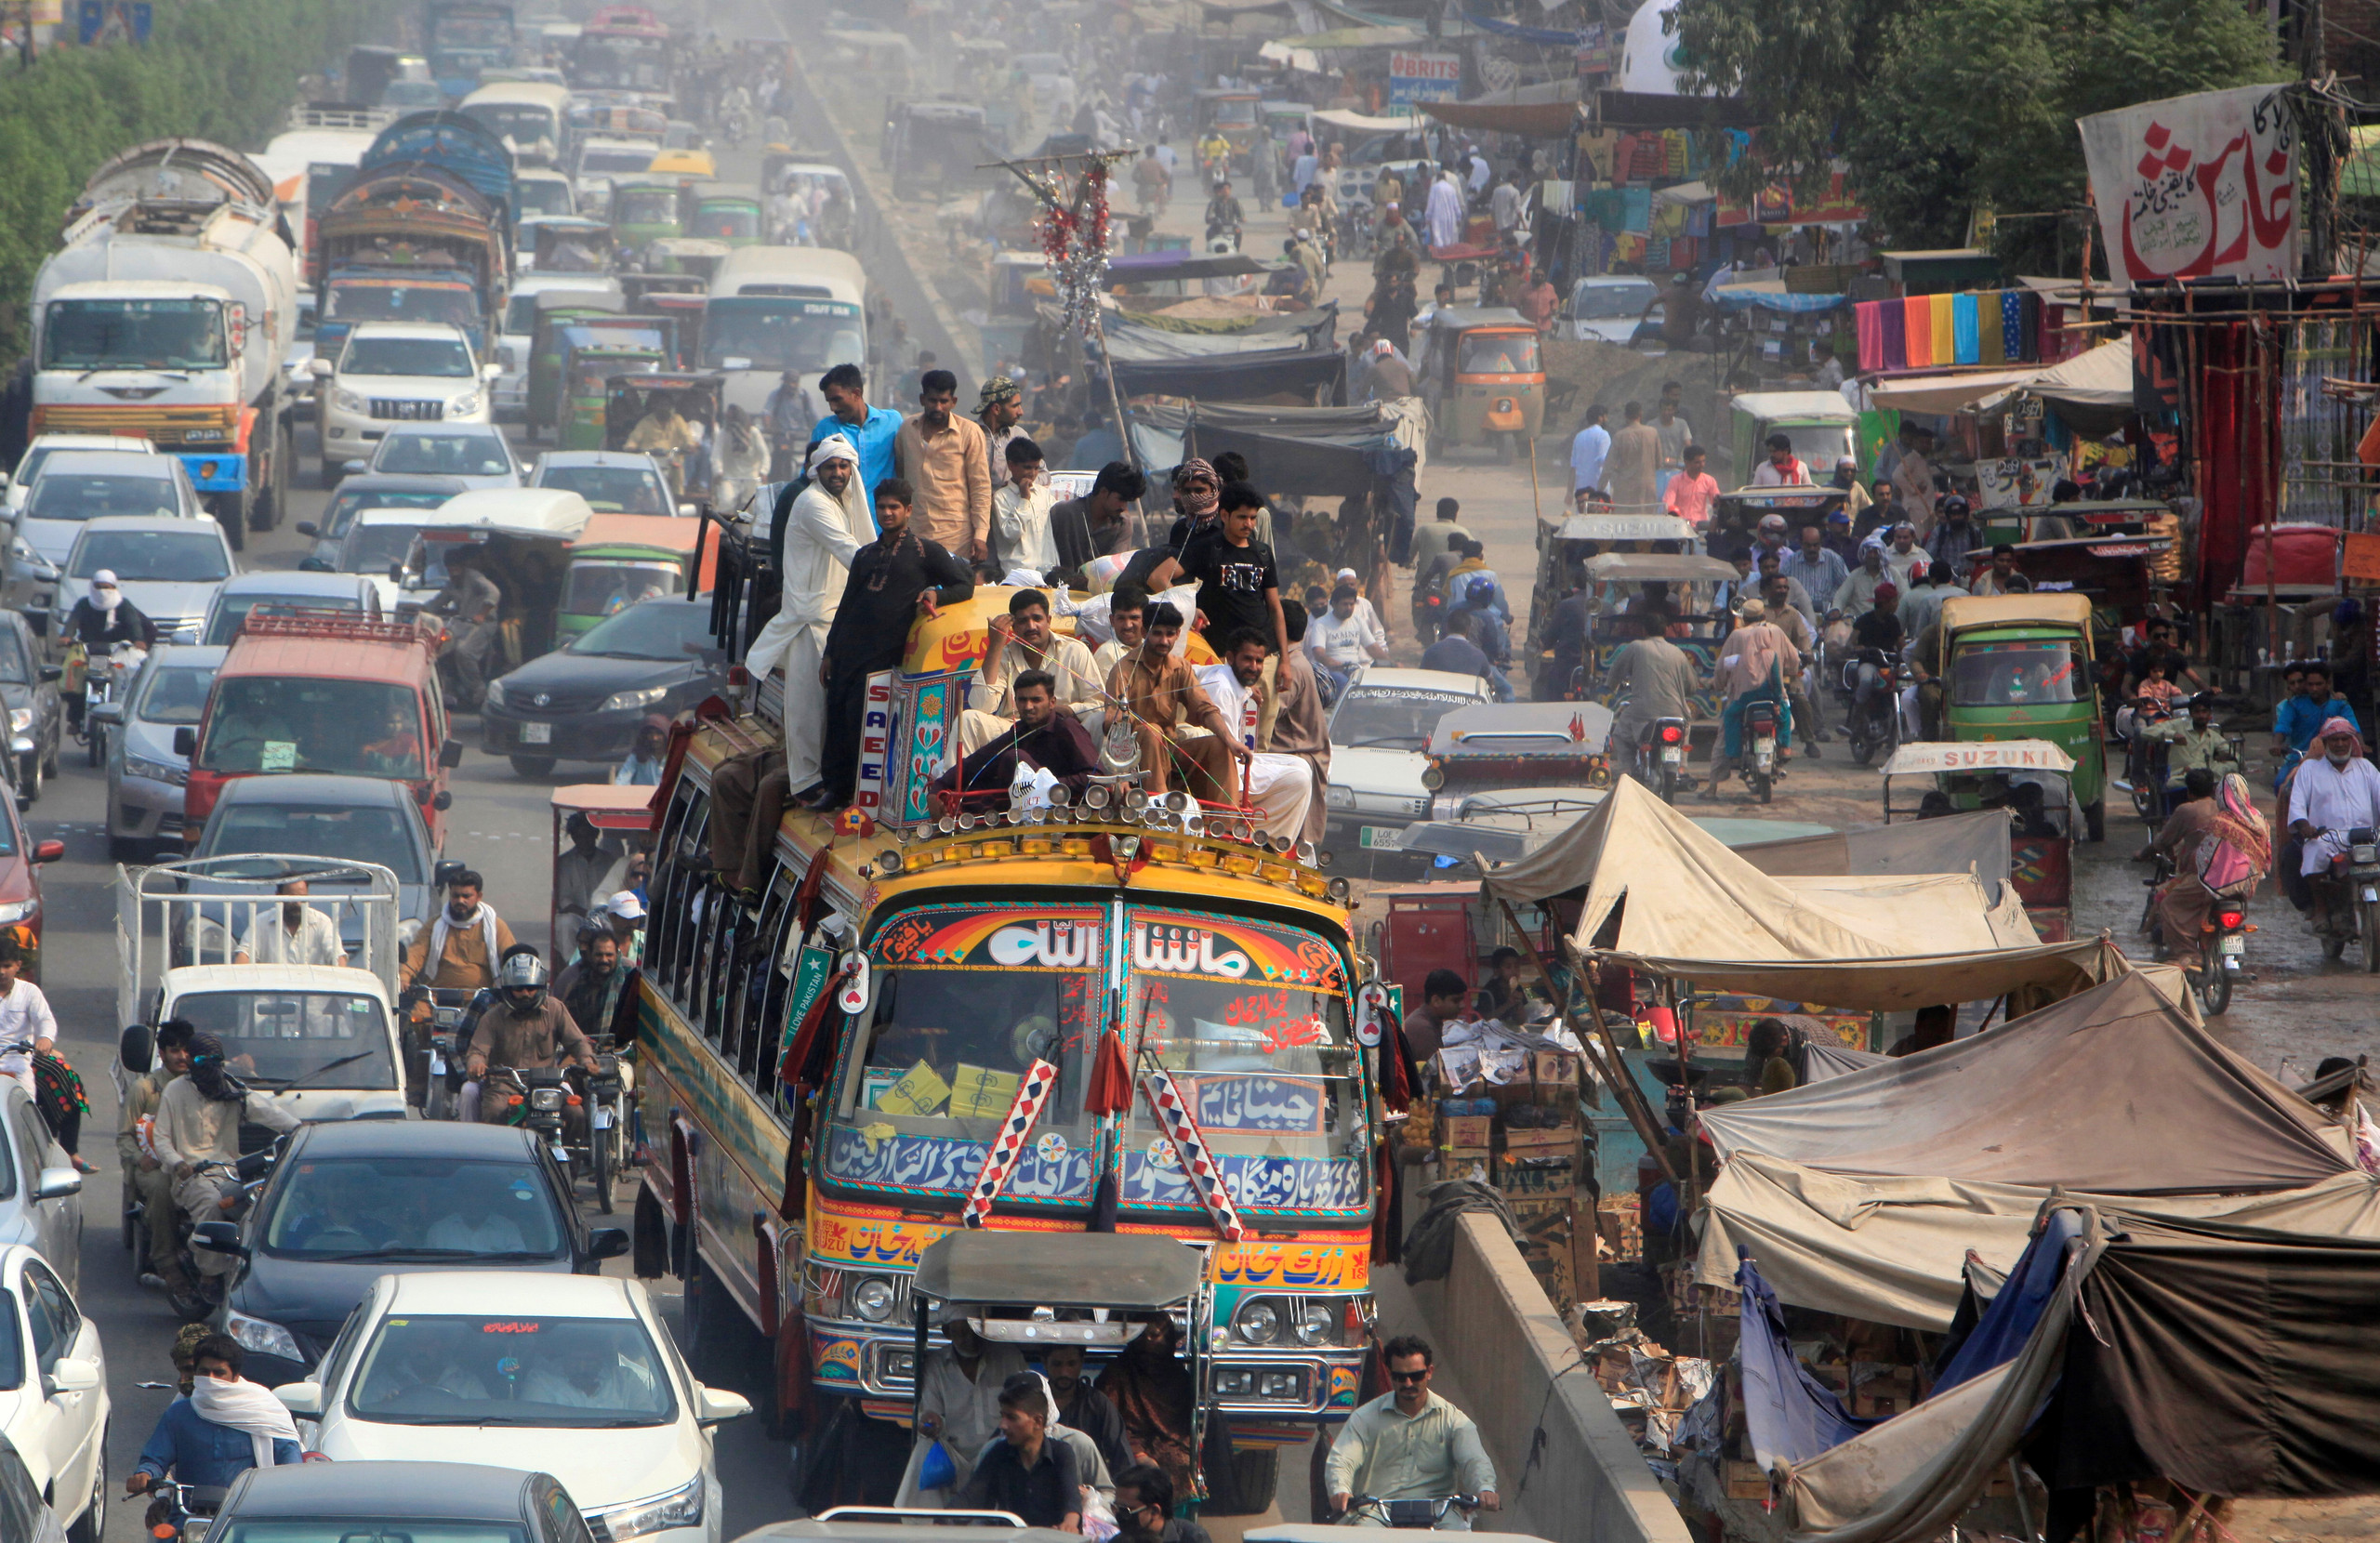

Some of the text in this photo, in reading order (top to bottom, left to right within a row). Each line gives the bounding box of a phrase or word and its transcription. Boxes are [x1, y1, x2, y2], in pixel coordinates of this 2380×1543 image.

[1405, 59, 1460, 78] BRITS
[804, 303, 850, 316] STAFF VAN
[1331, 630, 1360, 640] MAINE
[858, 685, 890, 809] SAEED
[1944, 750, 2049, 767] SUZUKI
[790, 1009, 806, 1032] LOVE
[800, 972, 823, 1010] PAKISTAN
[1200, 1077, 1316, 1131] چیتا ٹائم
